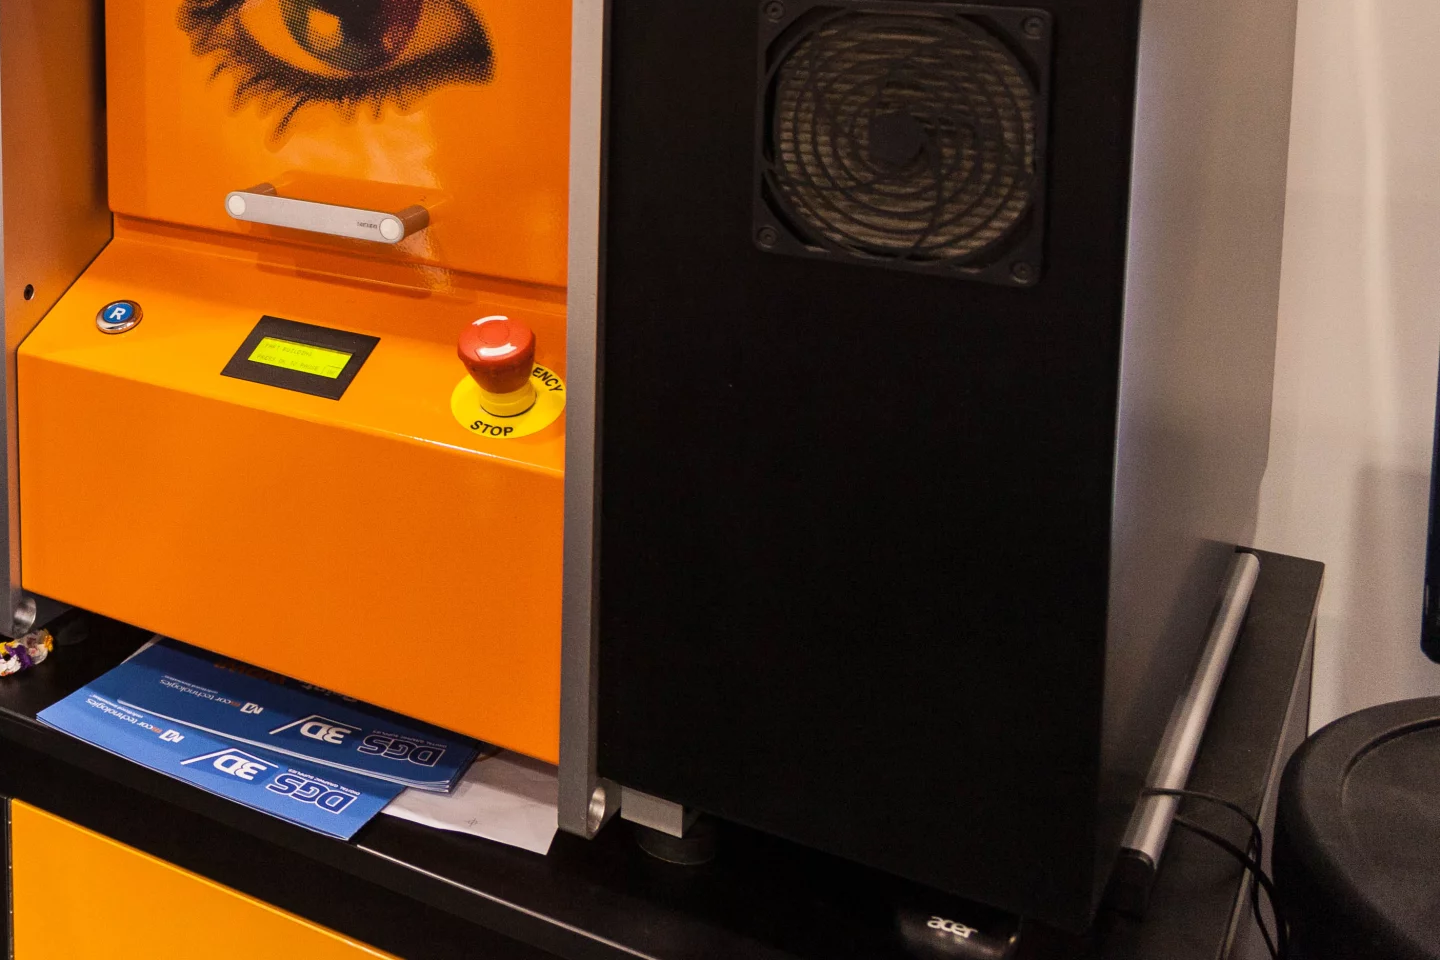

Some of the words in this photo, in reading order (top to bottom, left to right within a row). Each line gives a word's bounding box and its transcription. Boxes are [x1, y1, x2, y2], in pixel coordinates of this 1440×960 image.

[109, 306, 127, 321] R
[470, 420, 514, 437] STOP
[160, 678, 214, 702] technologies
[85, 698, 139, 726] technologies
[300, 721, 352, 745] 3D
[357, 734, 446, 767] DGS
[213, 753, 268, 781] 3D
[265, 773, 358, 815] DGS
[927, 915, 978, 939] acer
